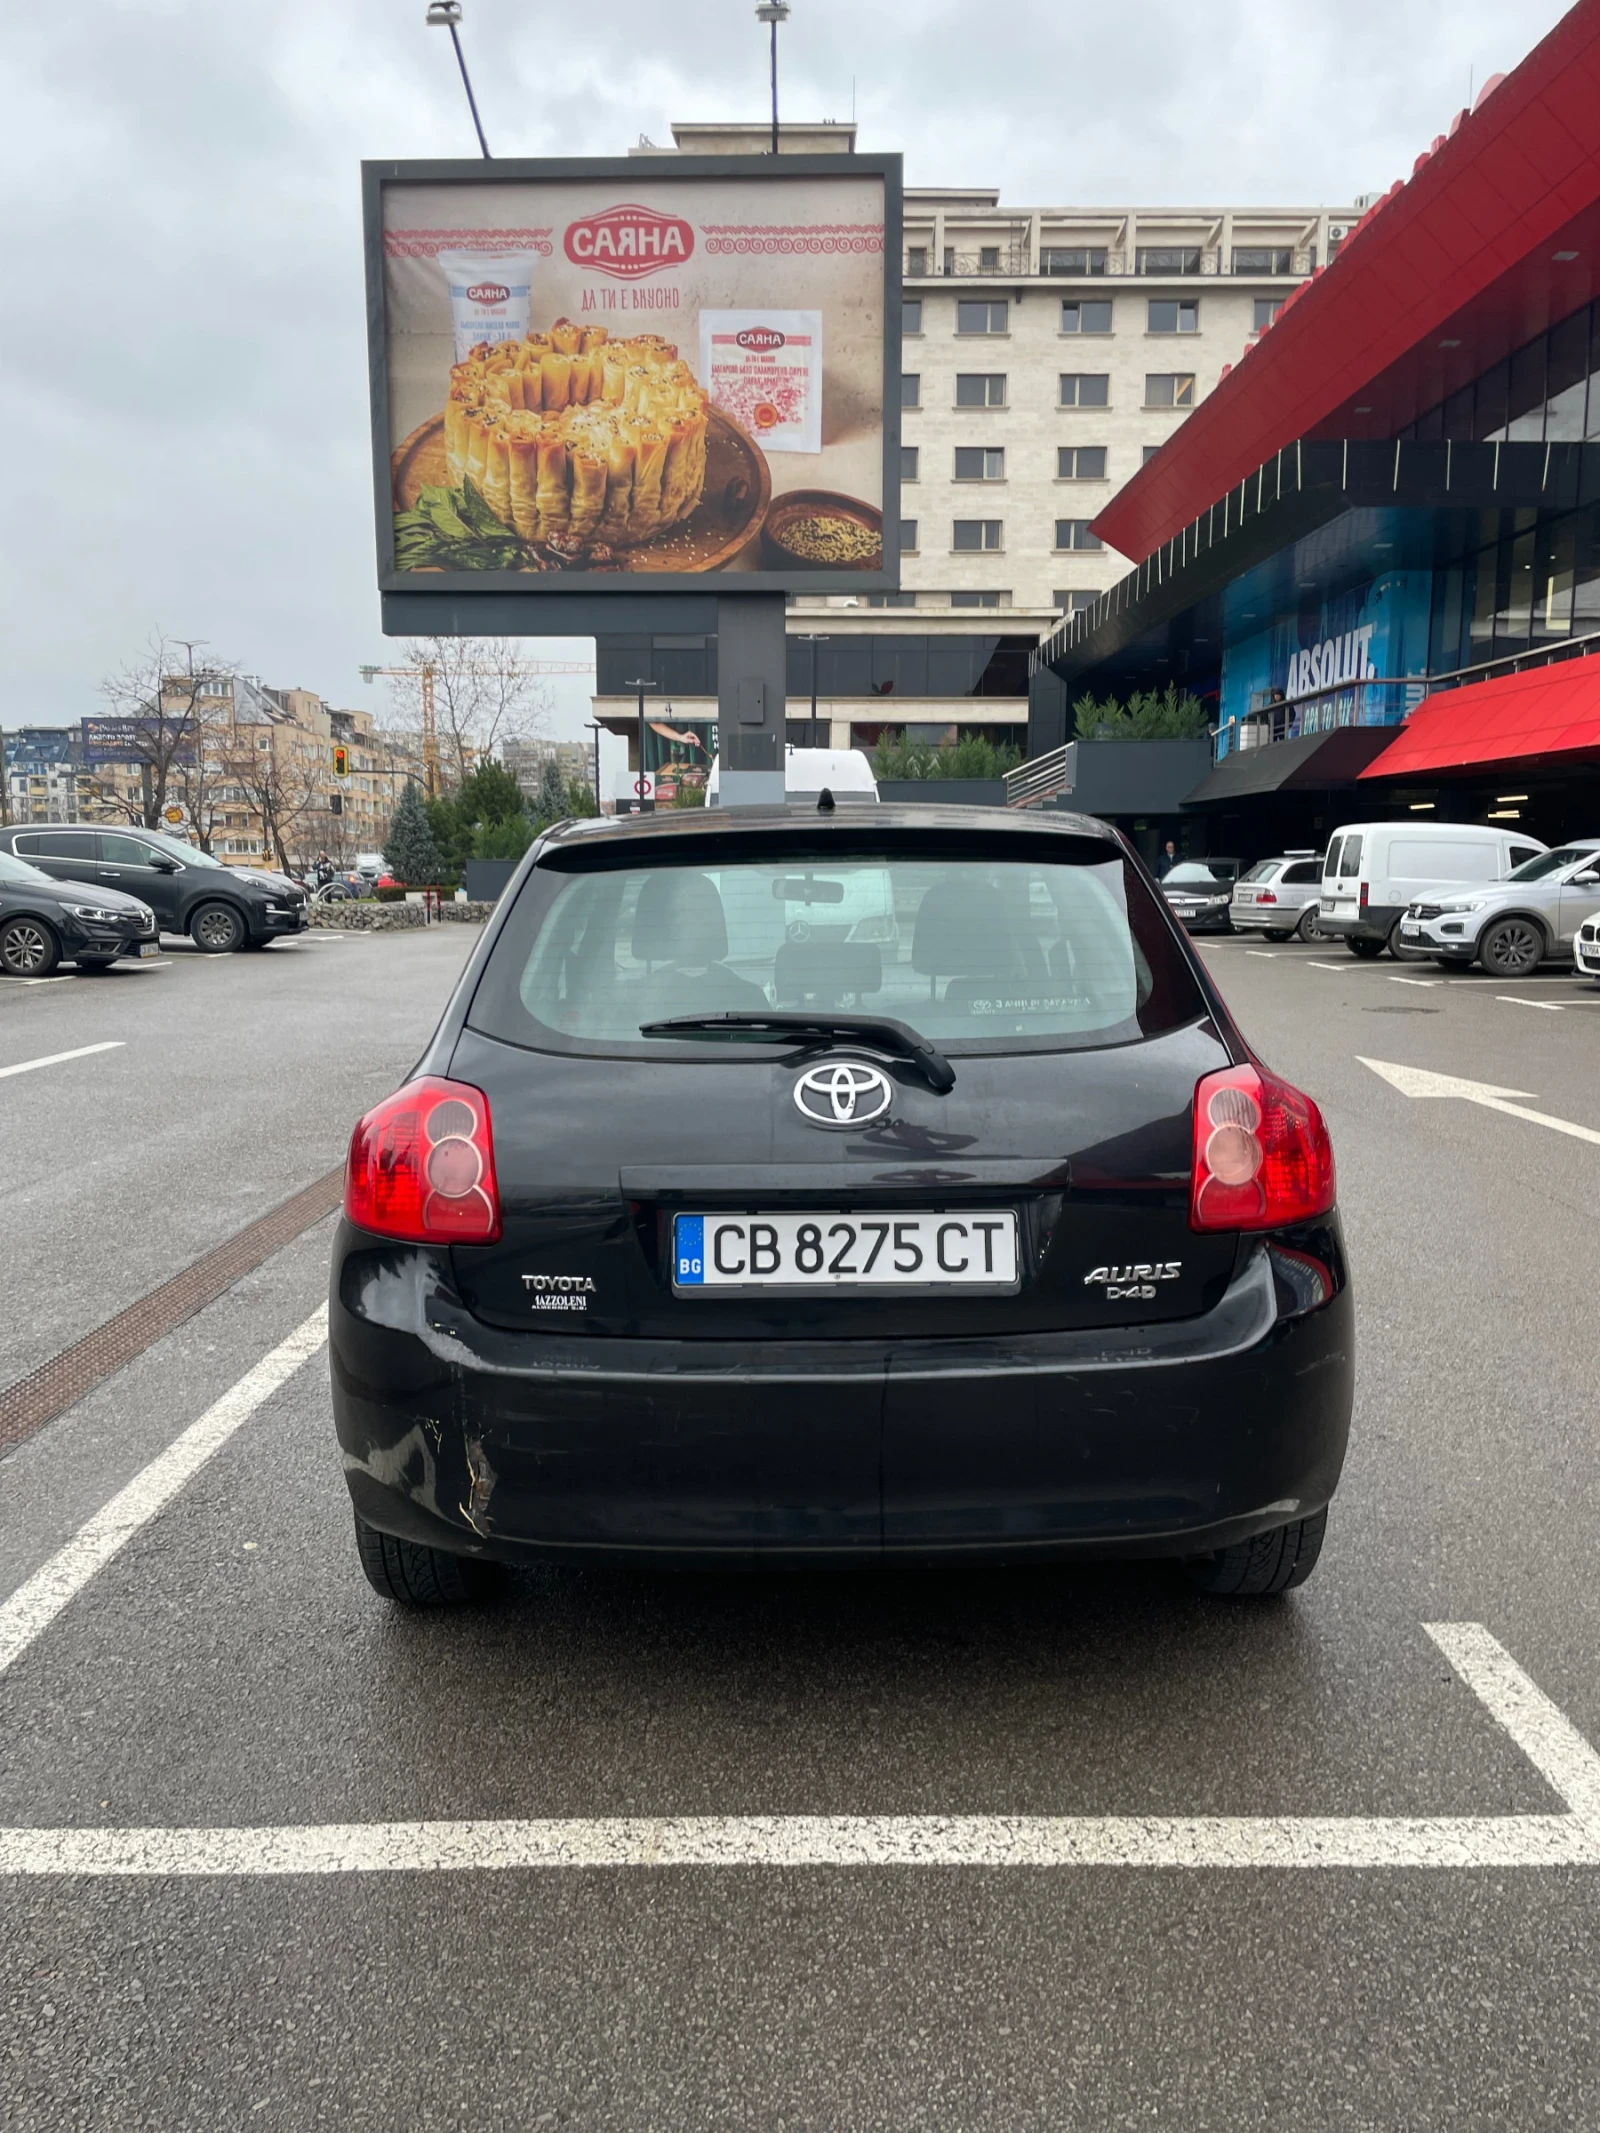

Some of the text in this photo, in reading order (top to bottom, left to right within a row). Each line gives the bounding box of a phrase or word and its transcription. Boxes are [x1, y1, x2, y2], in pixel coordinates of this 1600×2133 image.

[572, 226, 686, 258] САЯНА
[468, 288, 508, 299] САЯНА
[581, 287, 680, 312] ДА ТИ Е ВКУСНО
[739, 333, 782, 345] САЯНА
[1299, 706, 1319, 737] ORN
[1322, 702, 1332, 731] TO
[679, 1221, 1005, 1275] BG CB 8275 CT
[521, 1274, 597, 1293] TOYOTA
[1083, 1261, 1182, 1285] AURIS
[1106, 1284, 1157, 1300] D-4D
